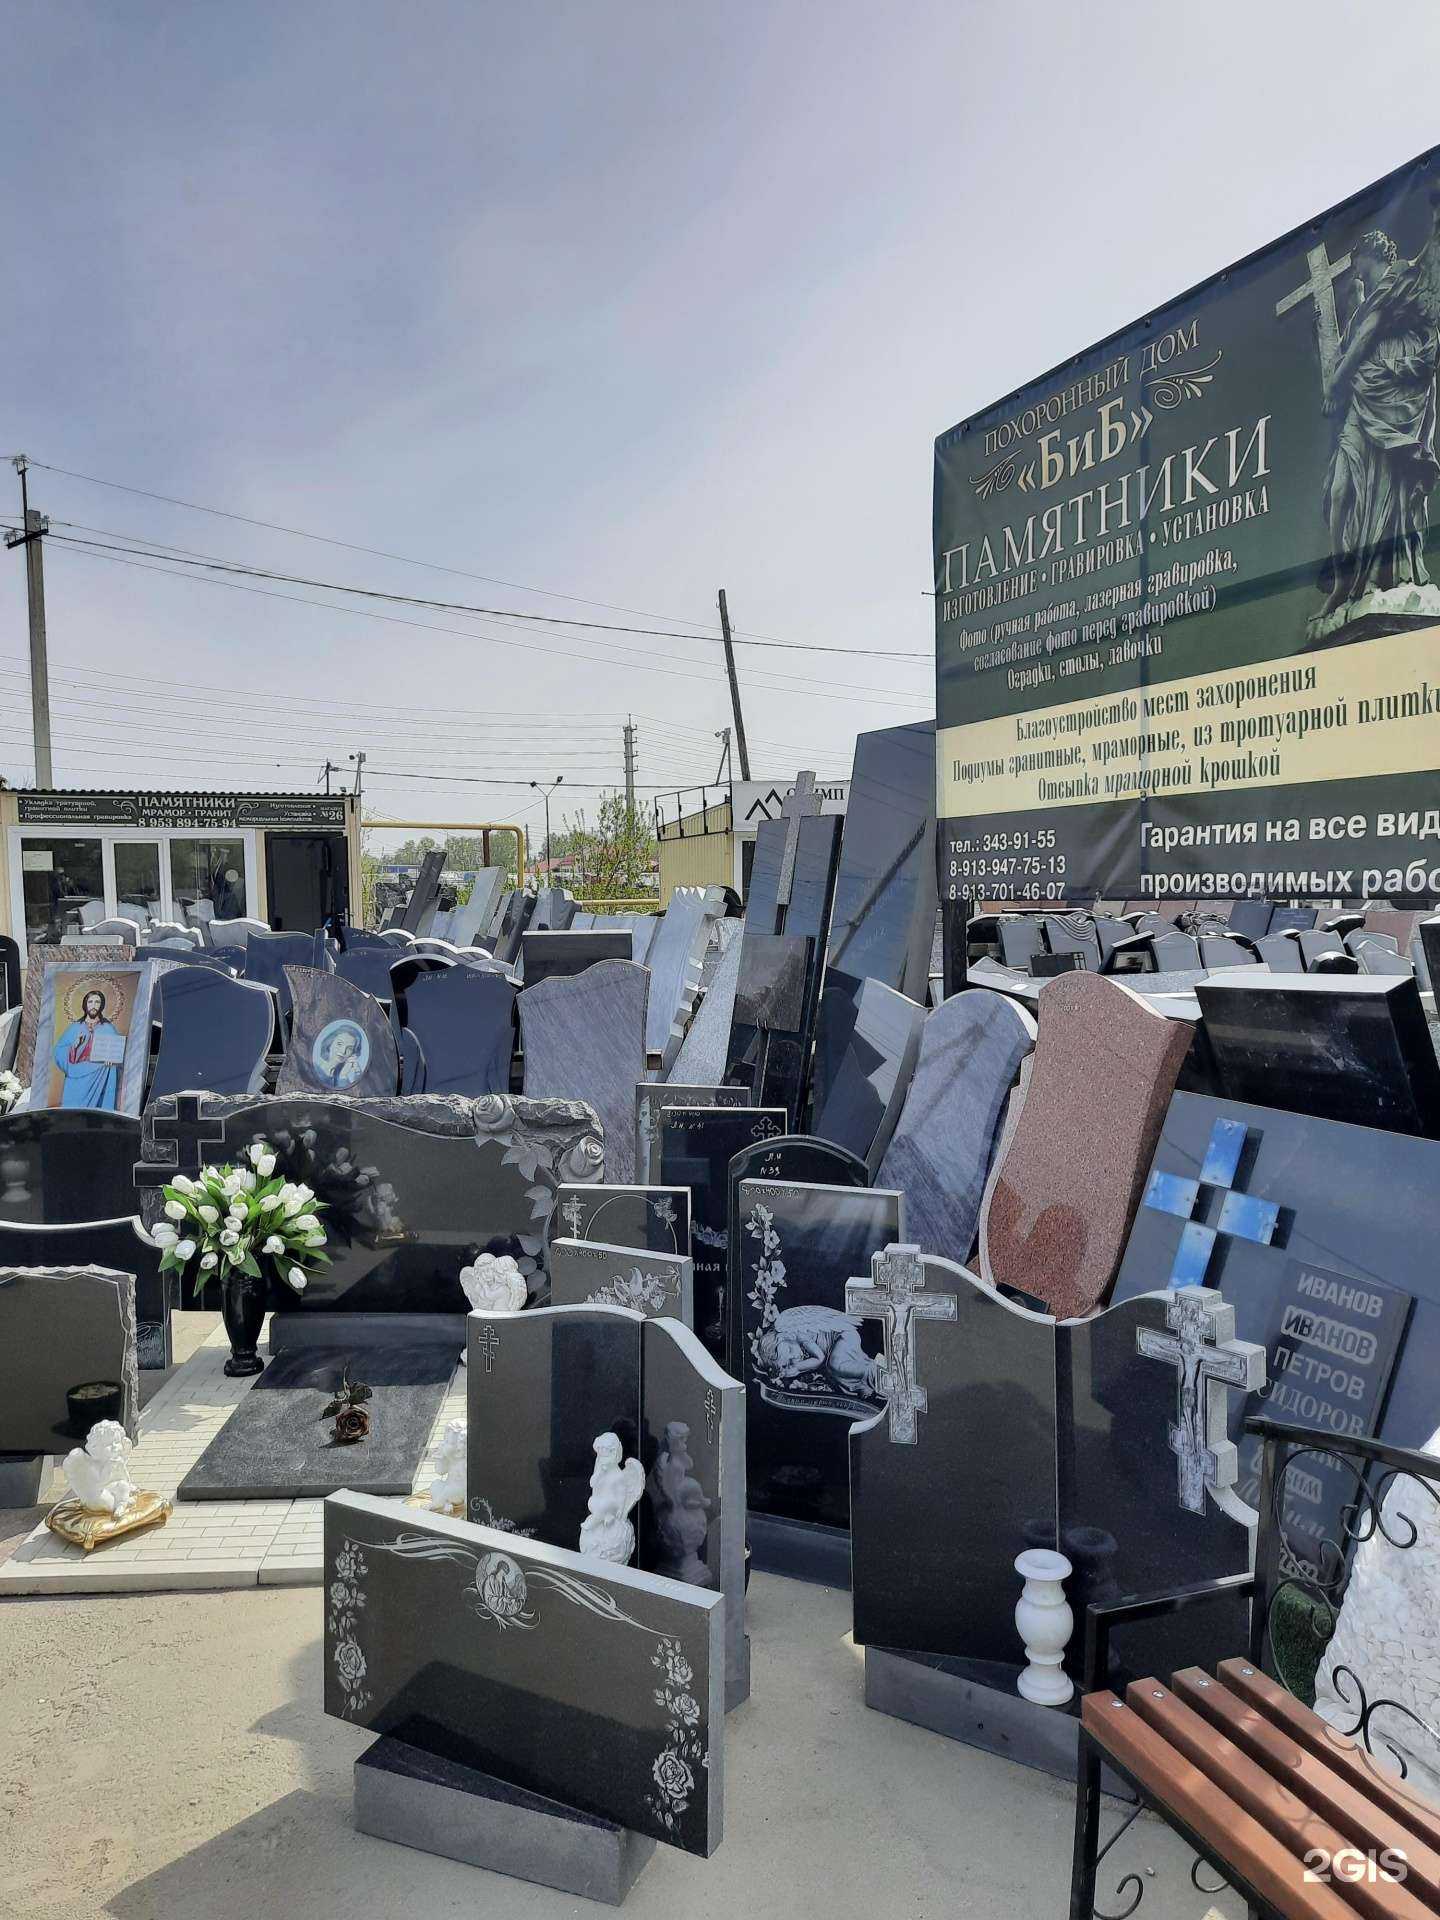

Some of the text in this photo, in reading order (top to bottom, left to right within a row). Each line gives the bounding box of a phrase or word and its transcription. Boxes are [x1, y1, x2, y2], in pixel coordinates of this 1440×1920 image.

[985, 320, 1199, 456] ПОХОРОННЫЙ ДОМ
[1018, 396, 1154, 493] «БиБ»
[943, 415, 1272, 594] ПАМЯТНИКИ
[943, 484, 1270, 622] ИЗГОТОВЛЕНИЕ ГРАВИРОВКА УСТАНОВКА
[960, 549, 1238, 651] Фото (ручная работа, лазерная гравировка,
[974, 585, 1217, 671] согласование фото перед гравировкой)
[1007, 633, 1163, 690] Оградки, столы, лавочки
[1016, 666, 1317, 741] Благоустройство мест захоронения
[952, 756, 1005, 784] Подиумы
[1008, 744, 1087, 775] гранитные,
[1092, 731, 1186, 766] мраморные,
[1194, 726, 1213, 747] из
[1220, 696, 1347, 743] тротуарной
[138, 796, 235, 808] ПАМЯТНИКИ
[1038, 748, 1282, 802] Отсыпка мраморной крошкой
[138, 818, 236, 828] 8 953 894-75-94
[142, 808, 232, 817] МРАМОР ГРАНИТ
[1140, 822, 1258, 848] Гарантия
[1266, 819, 1300, 842] на
[1309, 814, 1367, 840] все
[949, 830, 1056, 854] тел.: 343-91-55
[949, 855, 1066, 877] 8-913-947-75-13
[948, 881, 1066, 901] 8-913-701-46-07
[1140, 867, 1353, 899] производимых
[1297, 1271, 1384, 1318] ИВАНОВ
[1283, 1306, 1374, 1362] ИВАНОВ
[1273, 1346, 1366, 1400] ПЕТРОВ
